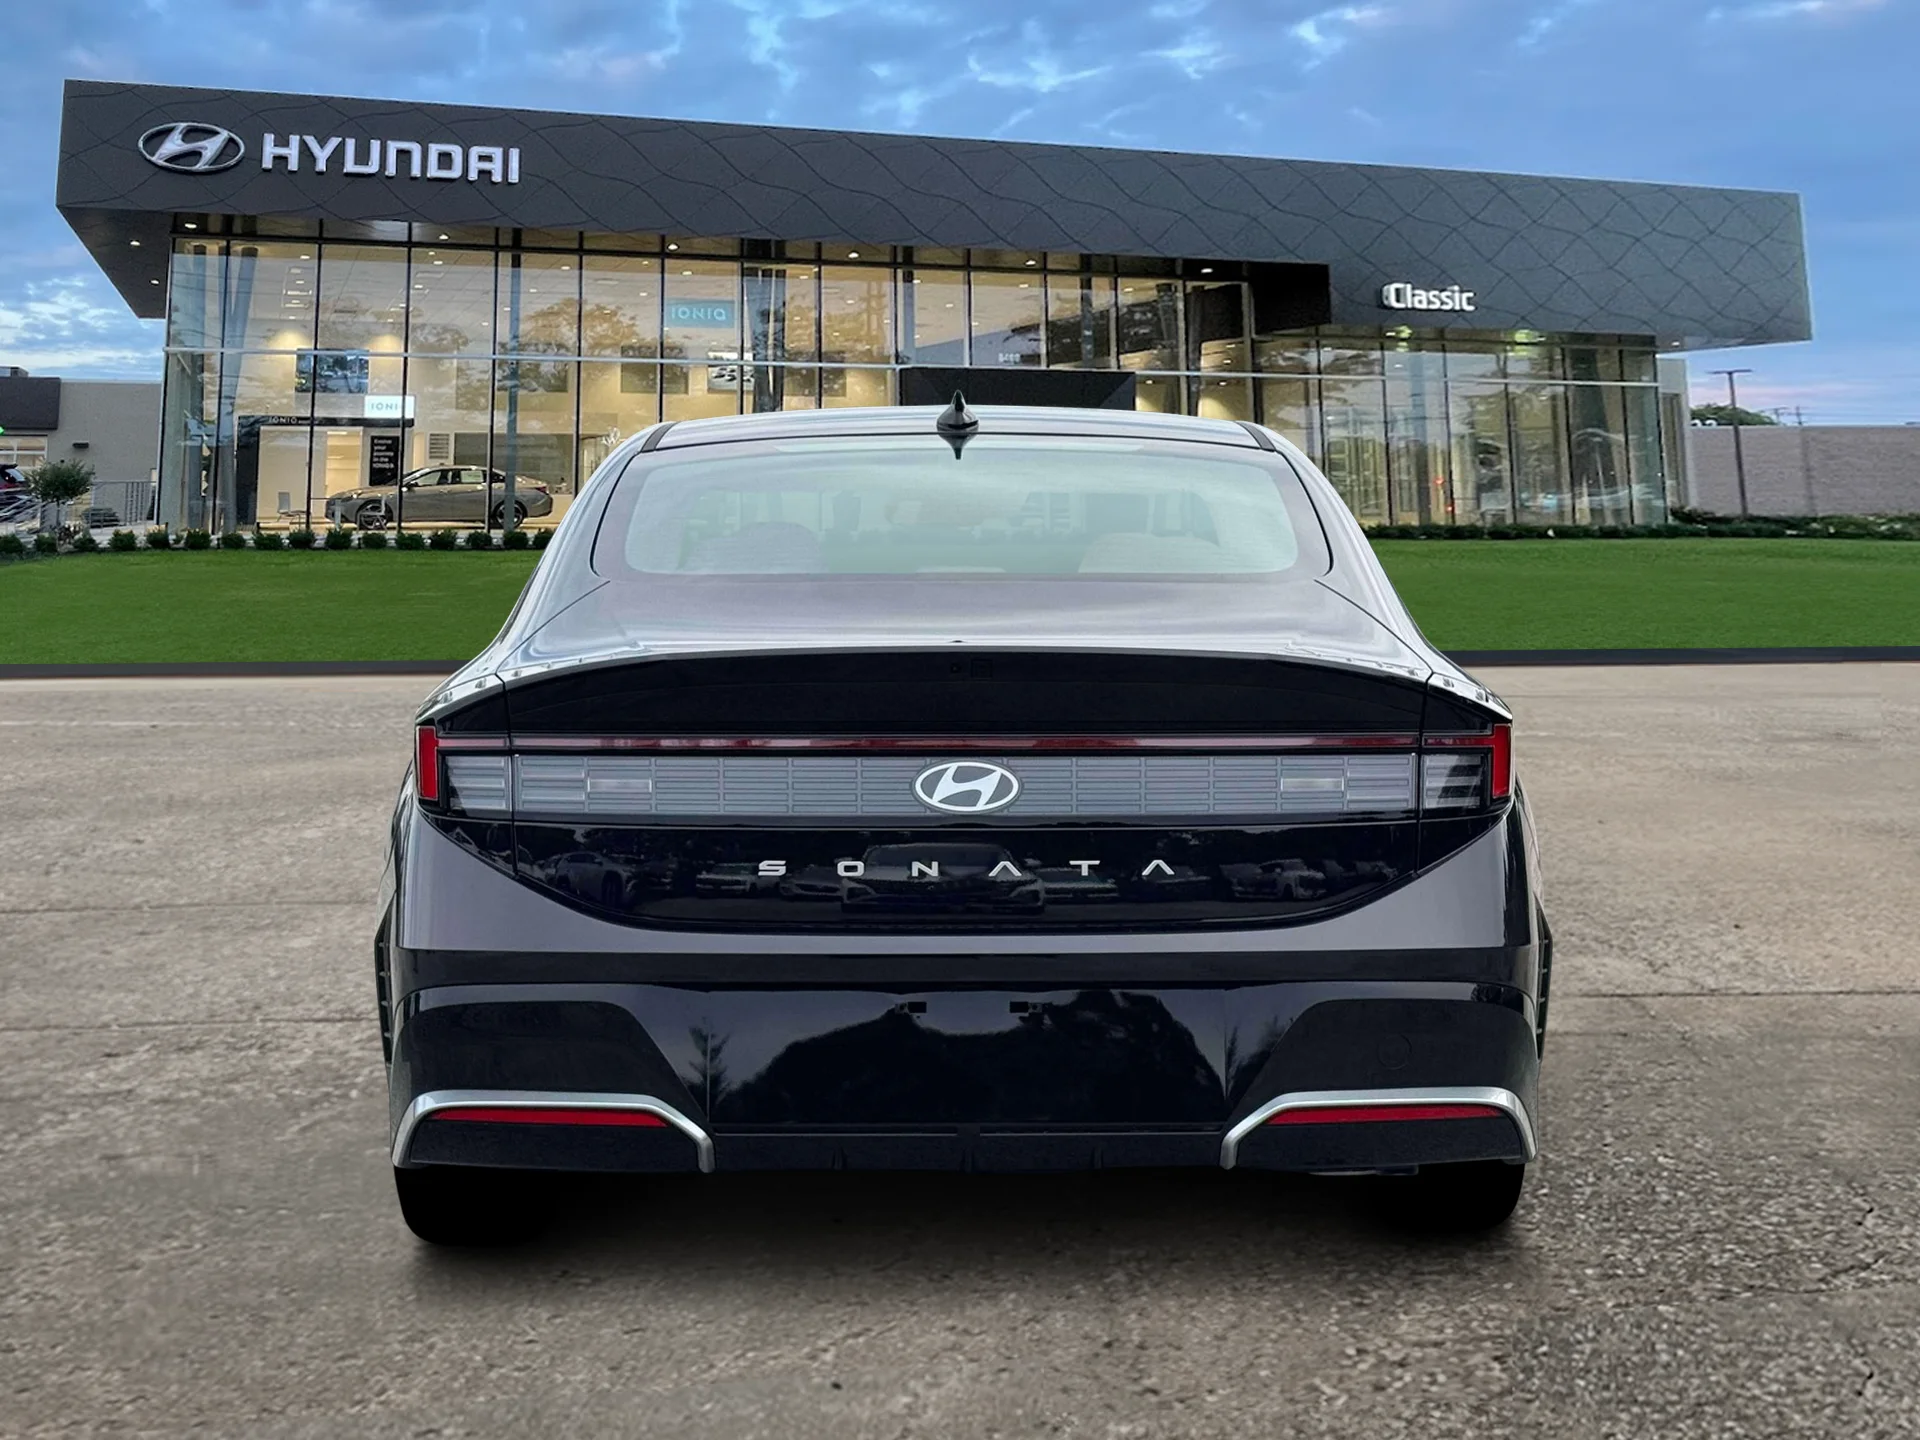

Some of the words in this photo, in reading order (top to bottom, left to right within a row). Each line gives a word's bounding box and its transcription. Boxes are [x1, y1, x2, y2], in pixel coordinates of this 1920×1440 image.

[261, 132, 521, 184] HYUNDAI
[1382, 282, 1477, 312] Classic
[671, 306, 727, 321] IONIQ
[370, 401, 404, 411] IONI
[758, 859, 1175, 877] SONATA
